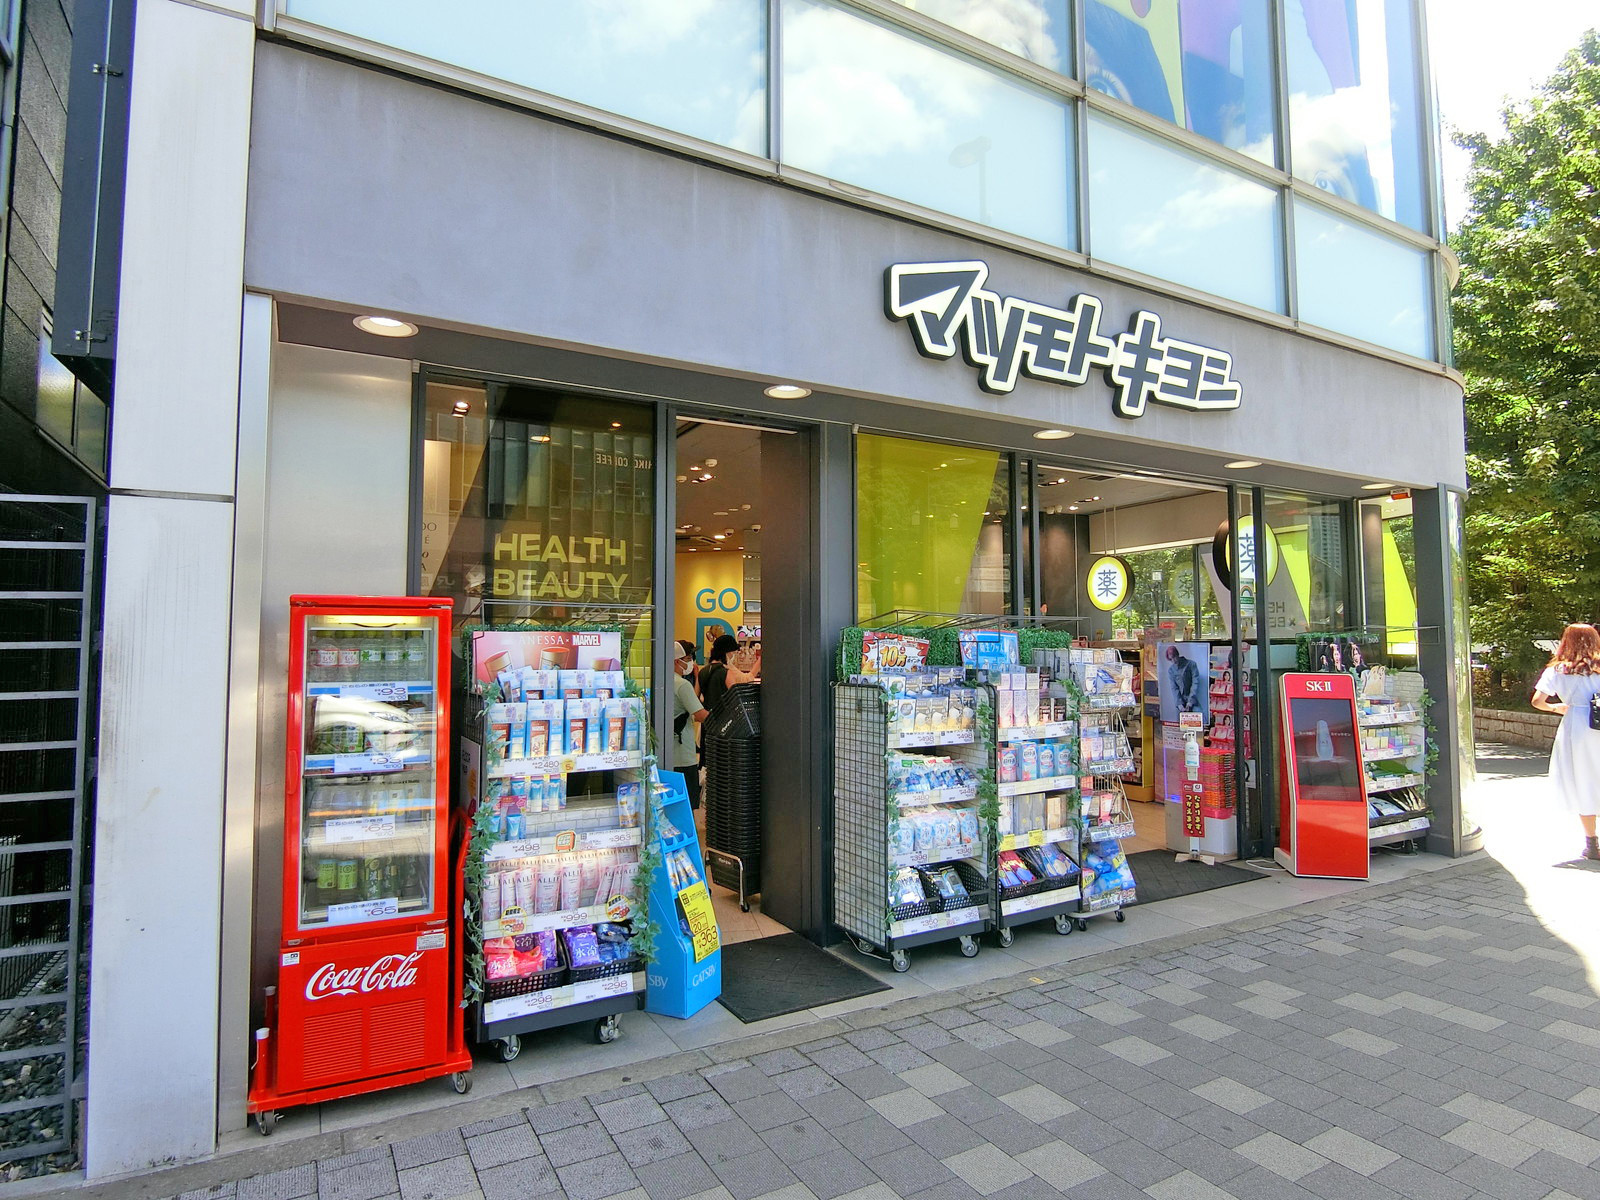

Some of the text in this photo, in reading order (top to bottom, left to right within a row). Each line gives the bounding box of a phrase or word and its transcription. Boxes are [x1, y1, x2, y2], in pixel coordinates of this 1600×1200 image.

[887, 260, 1243, 418] マツモトキヨシ
[493, 533, 626, 566] HEALTH
[493, 568, 628, 599] BEAUTY
[1097, 569, 1118, 597] 薬
[696, 588, 741, 613] GO
[520, 635, 565, 645] ANESSA
[572, 634, 600, 646] MARVEL
[1306, 681, 1333, 692] SK-II
[1185, 794, 1194, 834] つかえます。
[1194, 795, 1203, 835] たまります。
[371, 905, 397, 916] 65
[700, 925, 718, 947] 363
[305, 951, 426, 1001] Coca-Cola
[607, 980, 629, 991] 298
[692, 962, 718, 987] GATSBY
[530, 994, 553, 1007] 298
